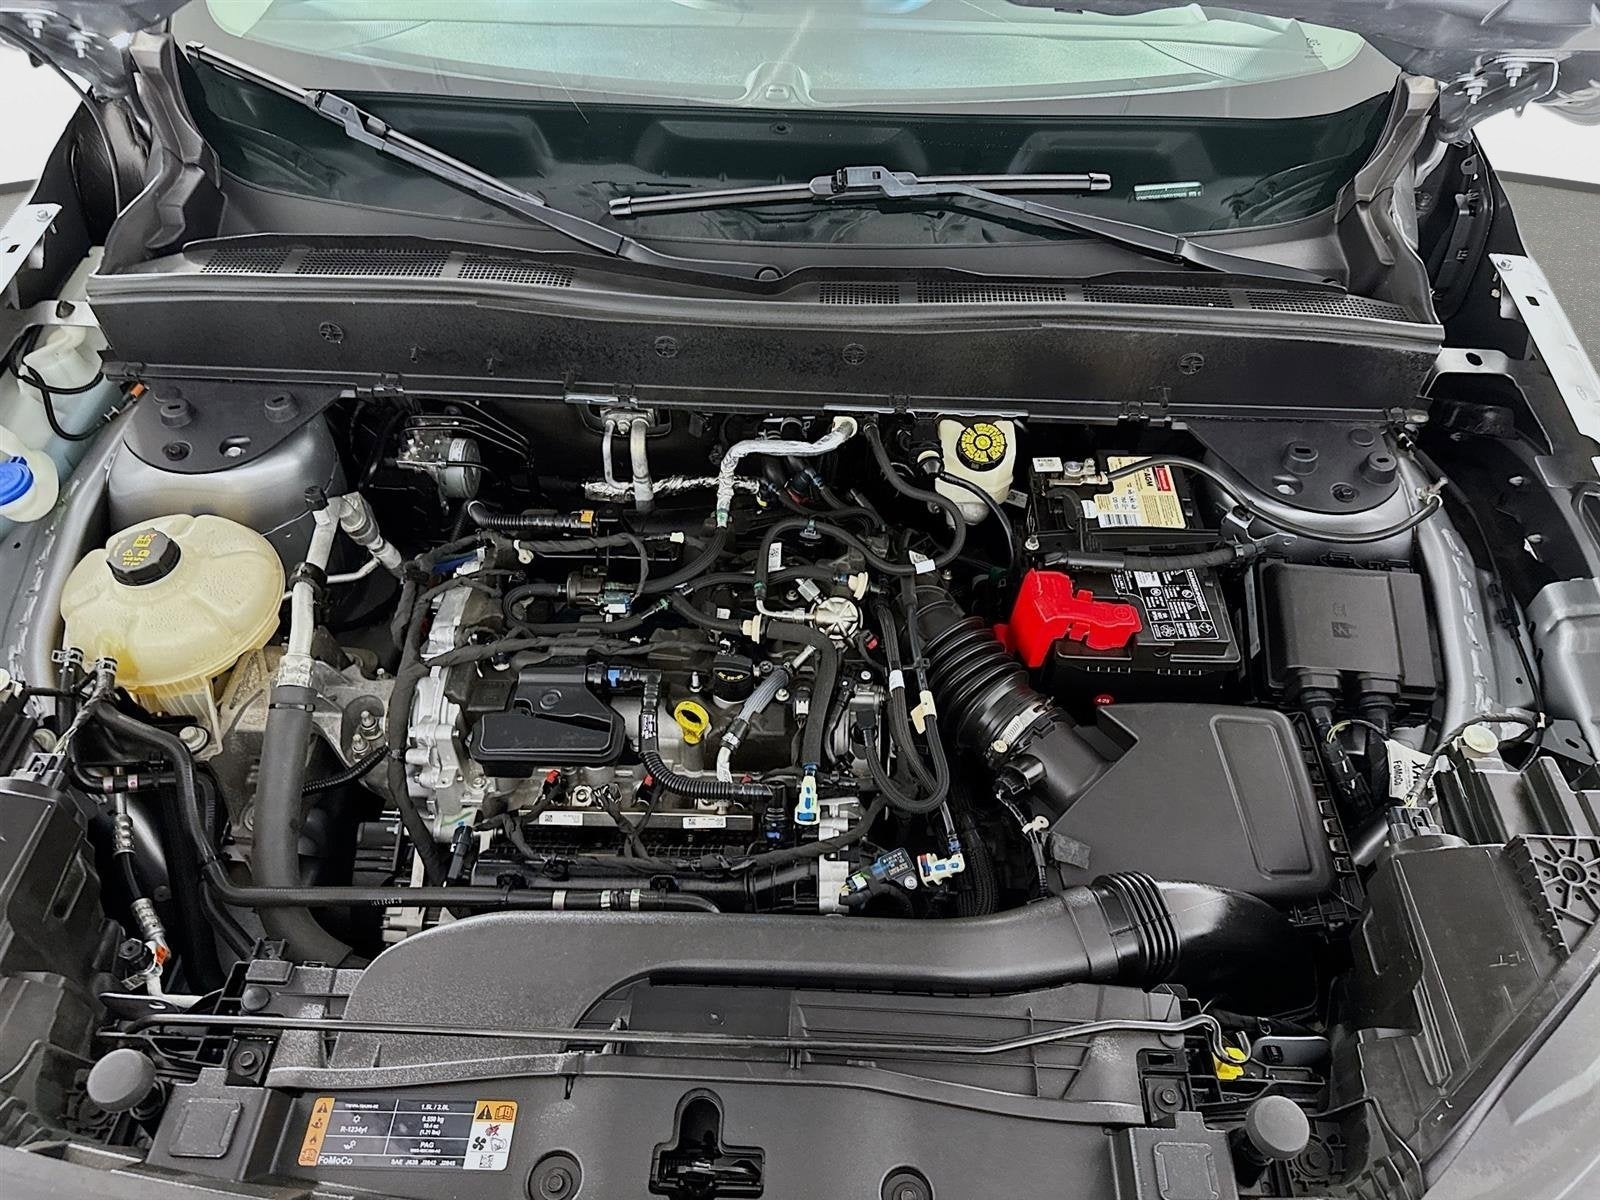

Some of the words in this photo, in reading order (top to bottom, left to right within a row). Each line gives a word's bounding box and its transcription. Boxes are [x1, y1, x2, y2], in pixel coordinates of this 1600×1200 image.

[1144, 473, 1154, 487] AGM
[340, 1126, 368, 1135] R-1234yf
[318, 1155, 353, 1165] FoMoCo
